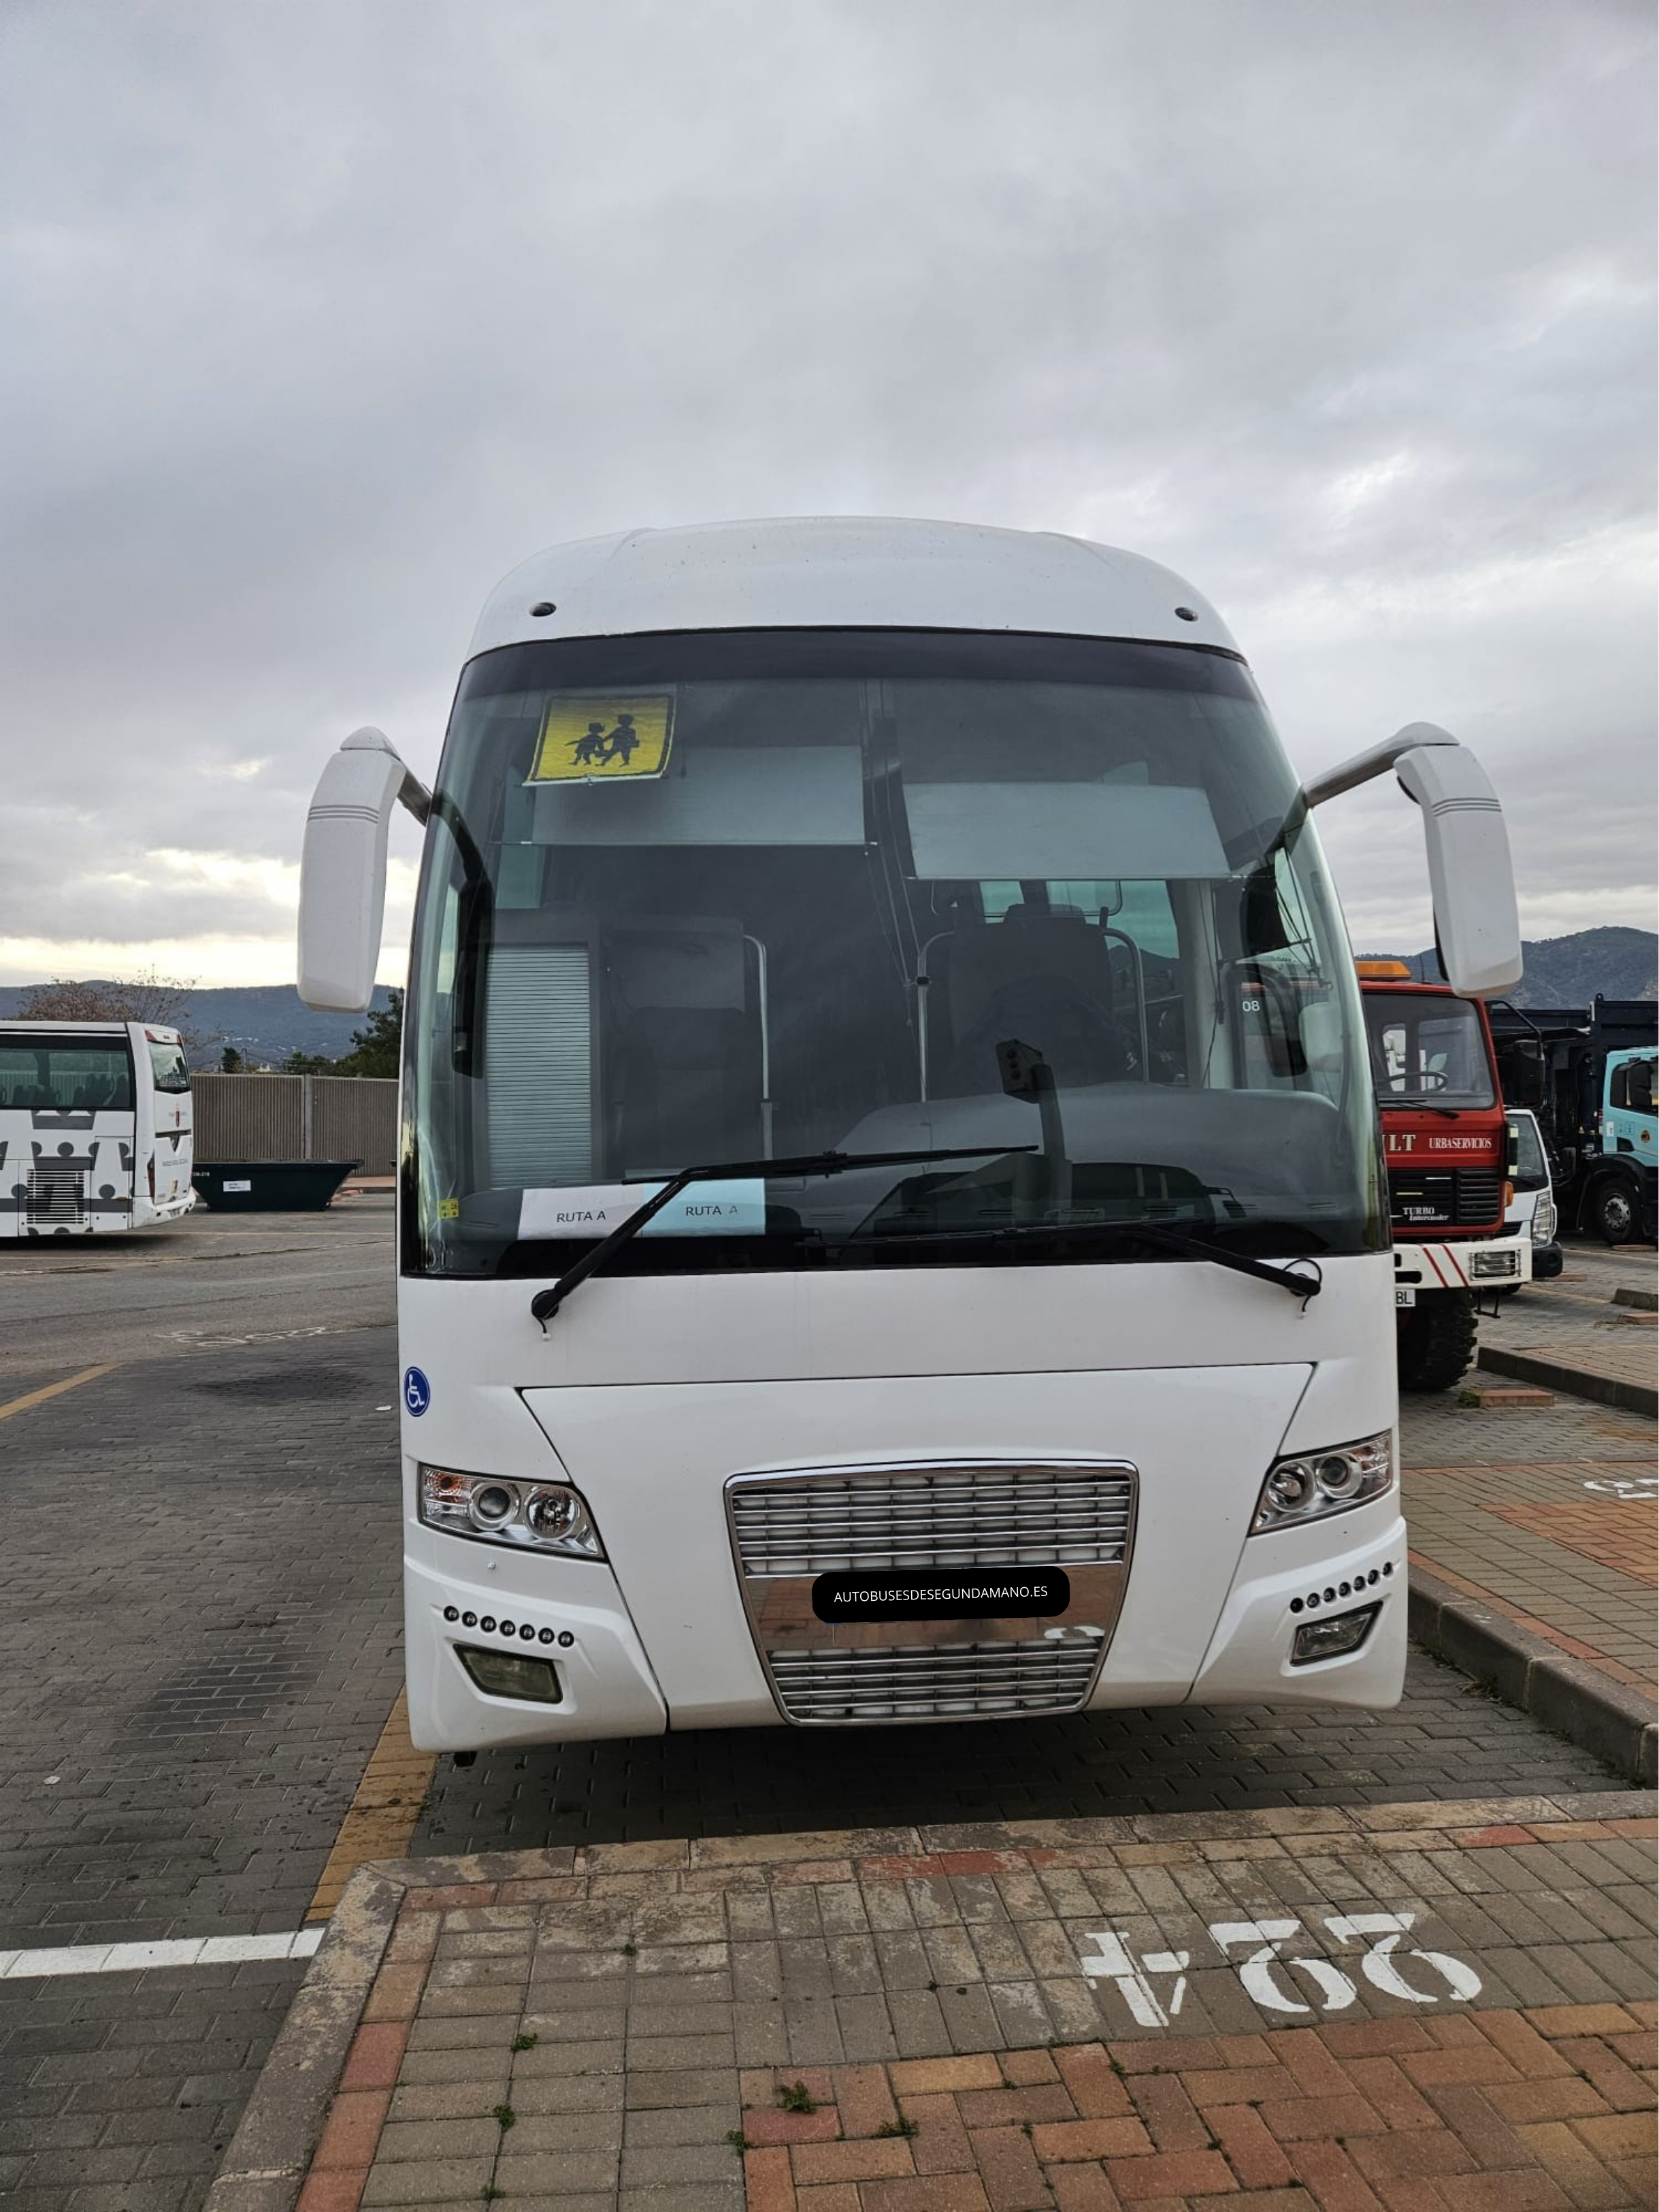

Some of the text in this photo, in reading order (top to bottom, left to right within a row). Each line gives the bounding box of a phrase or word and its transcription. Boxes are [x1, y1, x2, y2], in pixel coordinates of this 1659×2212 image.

[1242, 1001, 1260, 1012] 08
[1382, 1134, 1416, 1151] LT
[1428, 1137, 1492, 1149] URBASERVICIOS
[685, 1205, 738, 1216] RUTA A
[1402, 1207, 1435, 1215] TURBO
[557, 1211, 606, 1222] RUTA A
[1396, 1291, 1413, 1305] BL
[1081, 1913, 1482, 2027] 224
